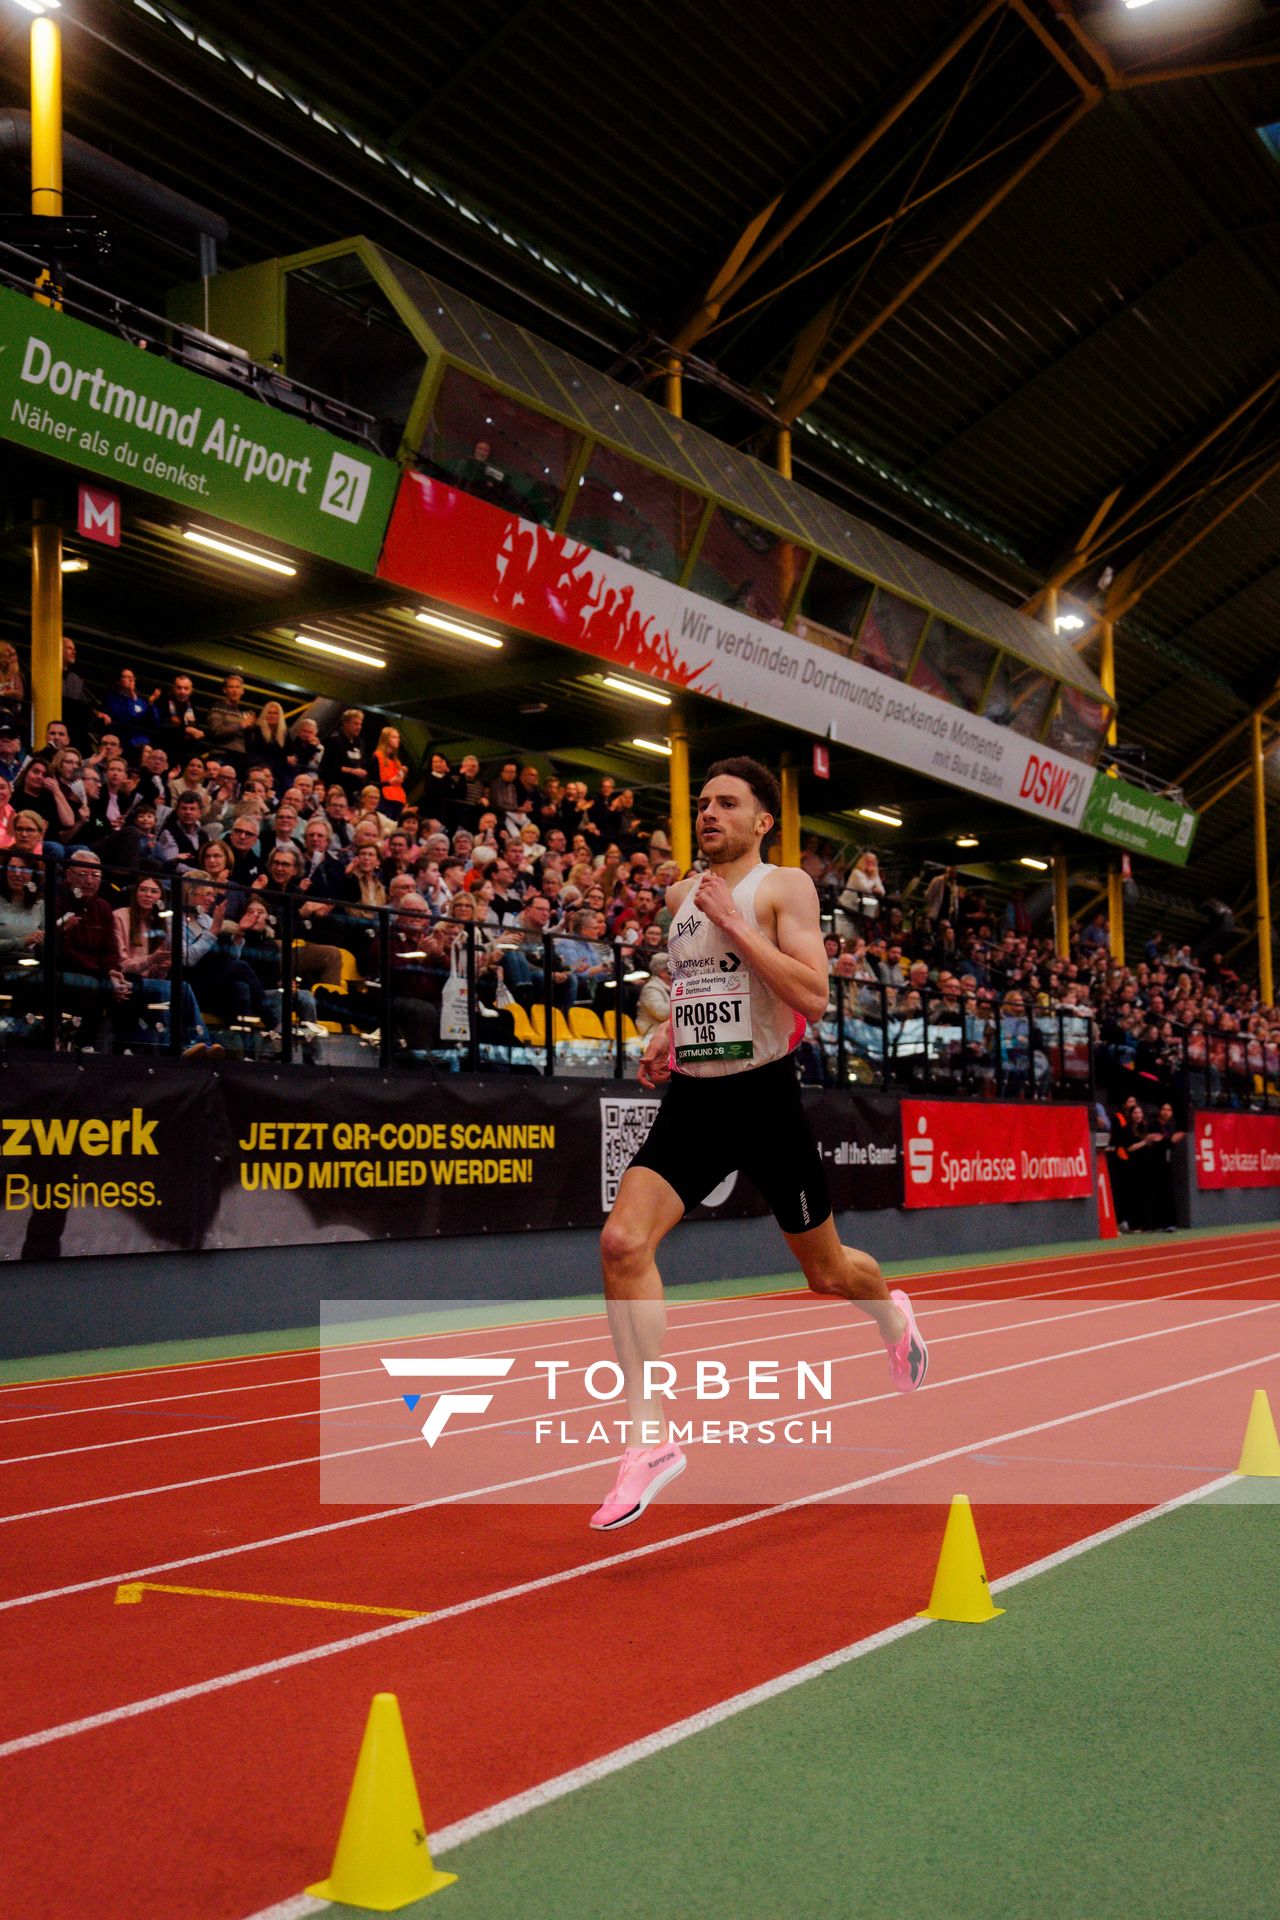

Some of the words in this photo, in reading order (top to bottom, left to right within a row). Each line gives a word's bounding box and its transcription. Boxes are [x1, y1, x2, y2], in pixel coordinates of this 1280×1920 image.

[20, 336, 201, 448] Dortmund
[202, 418, 312, 494] Airport
[11, 399, 75, 443] Näher
[79, 428, 109, 456] als
[114, 441, 141, 469] du
[143, 453, 210, 496] denkst.
[328, 469, 361, 512] 21
[84, 492, 116, 537] M
[680, 607, 713, 643] Wir
[716, 628, 799, 680] verbinden
[802, 658, 885, 714] Dortmunds
[884, 697, 949, 738] packende
[949, 721, 1004, 762] Momente
[817, 747, 827, 772] L
[932, 750, 949, 769] mit
[950, 753, 969, 775] Bus
[1019, 754, 1085, 816] DSW21
[686, 986, 711, 995] Dortmund
[701, 976, 726, 984] Meeting
[675, 1000, 742, 1028] PROBST
[694, 1025, 716, 1043] 146
[714, 1047, 725, 1055] 26
[0, 1108, 159, 1156] zwerk
[239, 1123, 328, 1150] JETZT
[333, 1123, 447, 1150] QR-CODE
[450, 1124, 555, 1149] SCANNEN
[834, 1142, 848, 1164] all
[849, 1142, 867, 1164] the
[240, 1162, 304, 1190] UND
[308, 1160, 427, 1189] MITGLIED
[430, 1159, 532, 1185] WERDEN!
[941, 1150, 1016, 1190] Sparkasse
[1021, 1148, 1087, 1180] Dortmund
[5, 1172, 162, 1210] Business.
